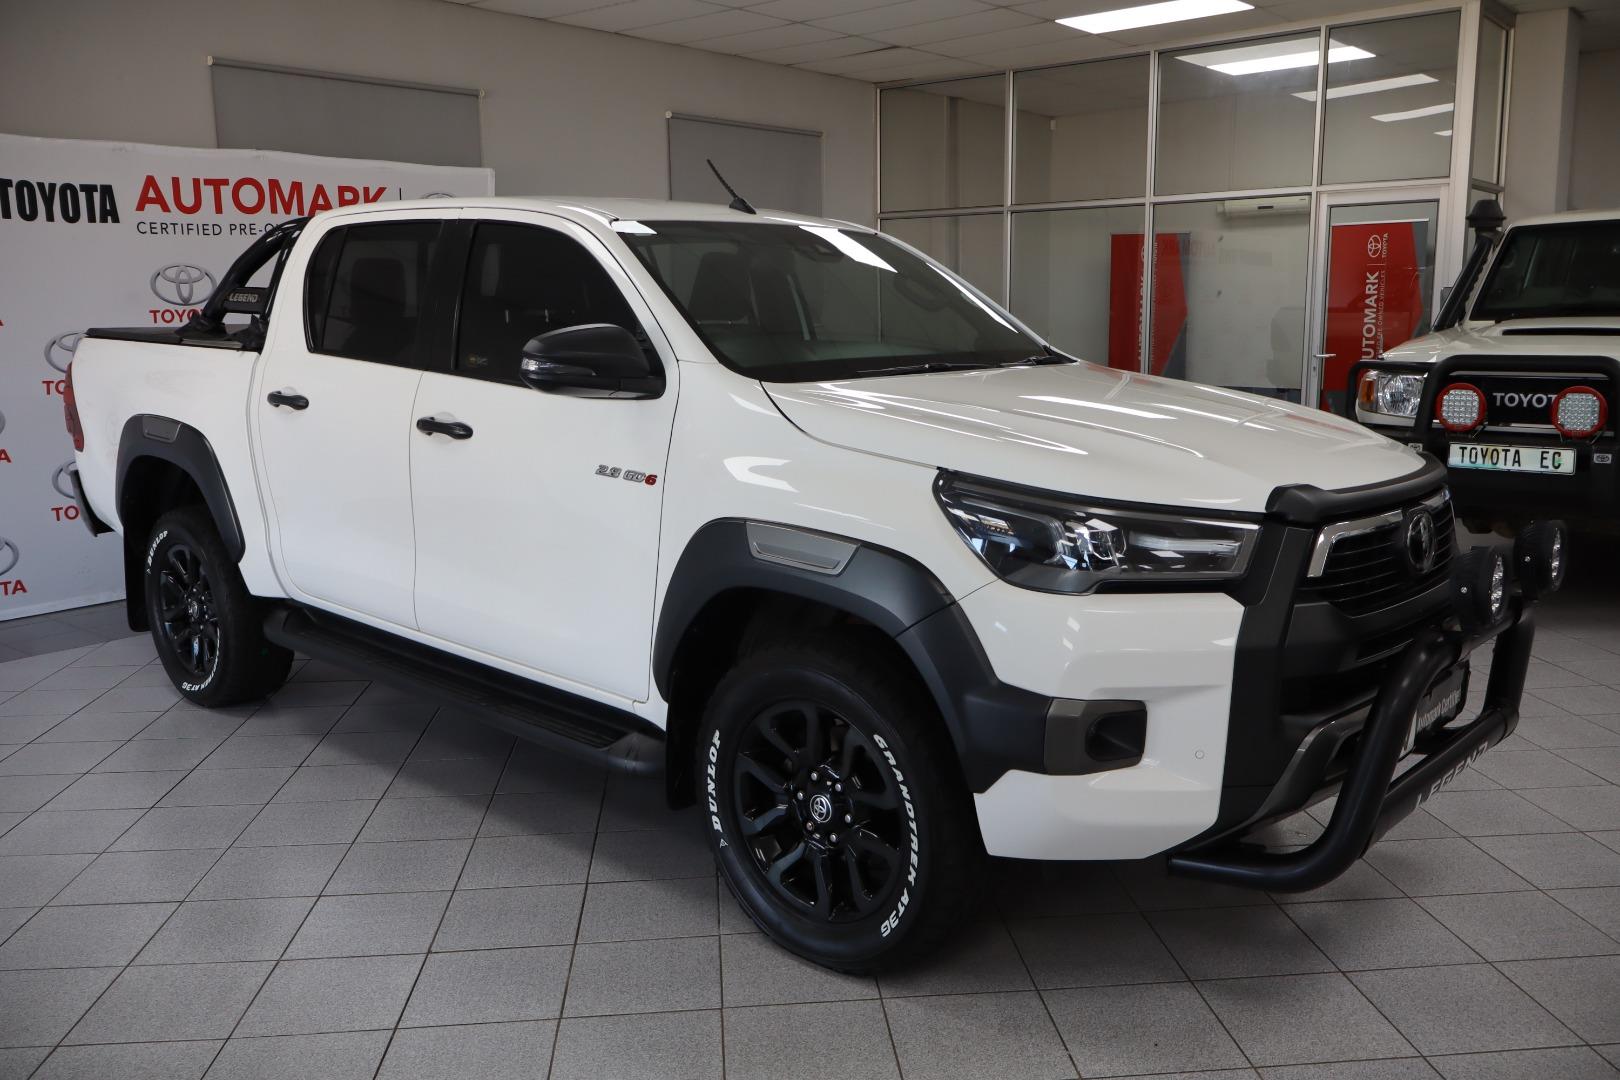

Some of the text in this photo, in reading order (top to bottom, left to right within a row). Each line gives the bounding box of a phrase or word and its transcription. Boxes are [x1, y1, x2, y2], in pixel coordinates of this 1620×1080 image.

[0, 178, 120, 224] TOYOTA
[136, 221, 276, 237] CERTIFIED PRE-O
[228, 293, 259, 303] LEGEND
[149, 308, 200, 324] TOYO
[1361, 270, 1379, 360] UTOMARK
[1492, 392, 1558, 408] TOYOT
[1459, 446, 1563, 470] TOYOTA EC
[147, 530, 169, 566] DUNLOP
[707, 729, 723, 833] DUNLOP
[873, 733, 919, 938] GRANDTREK AT3G
